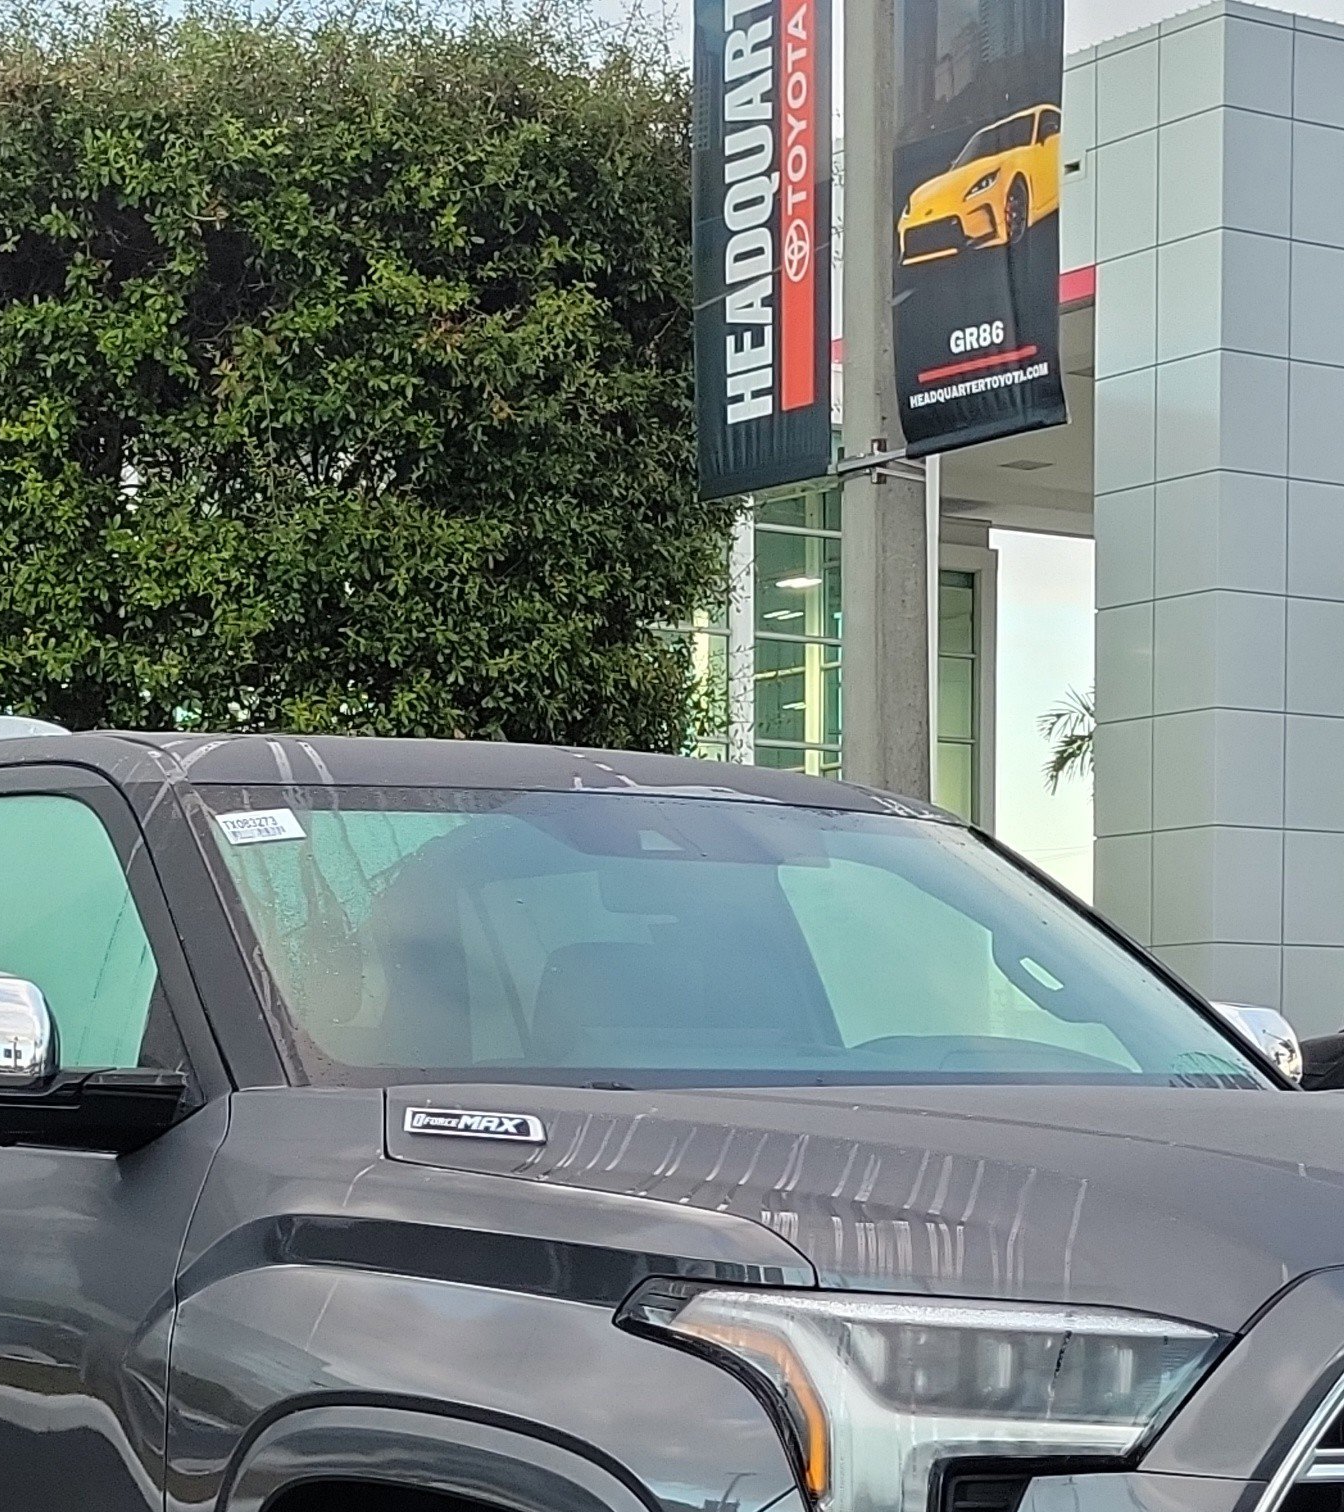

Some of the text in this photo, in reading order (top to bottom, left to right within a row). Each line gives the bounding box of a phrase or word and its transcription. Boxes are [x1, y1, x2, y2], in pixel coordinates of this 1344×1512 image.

[787, 3, 807, 215] TOYOTA
[949, 320, 1004, 354] GR86
[458, 1115, 523, 1133] MAX
